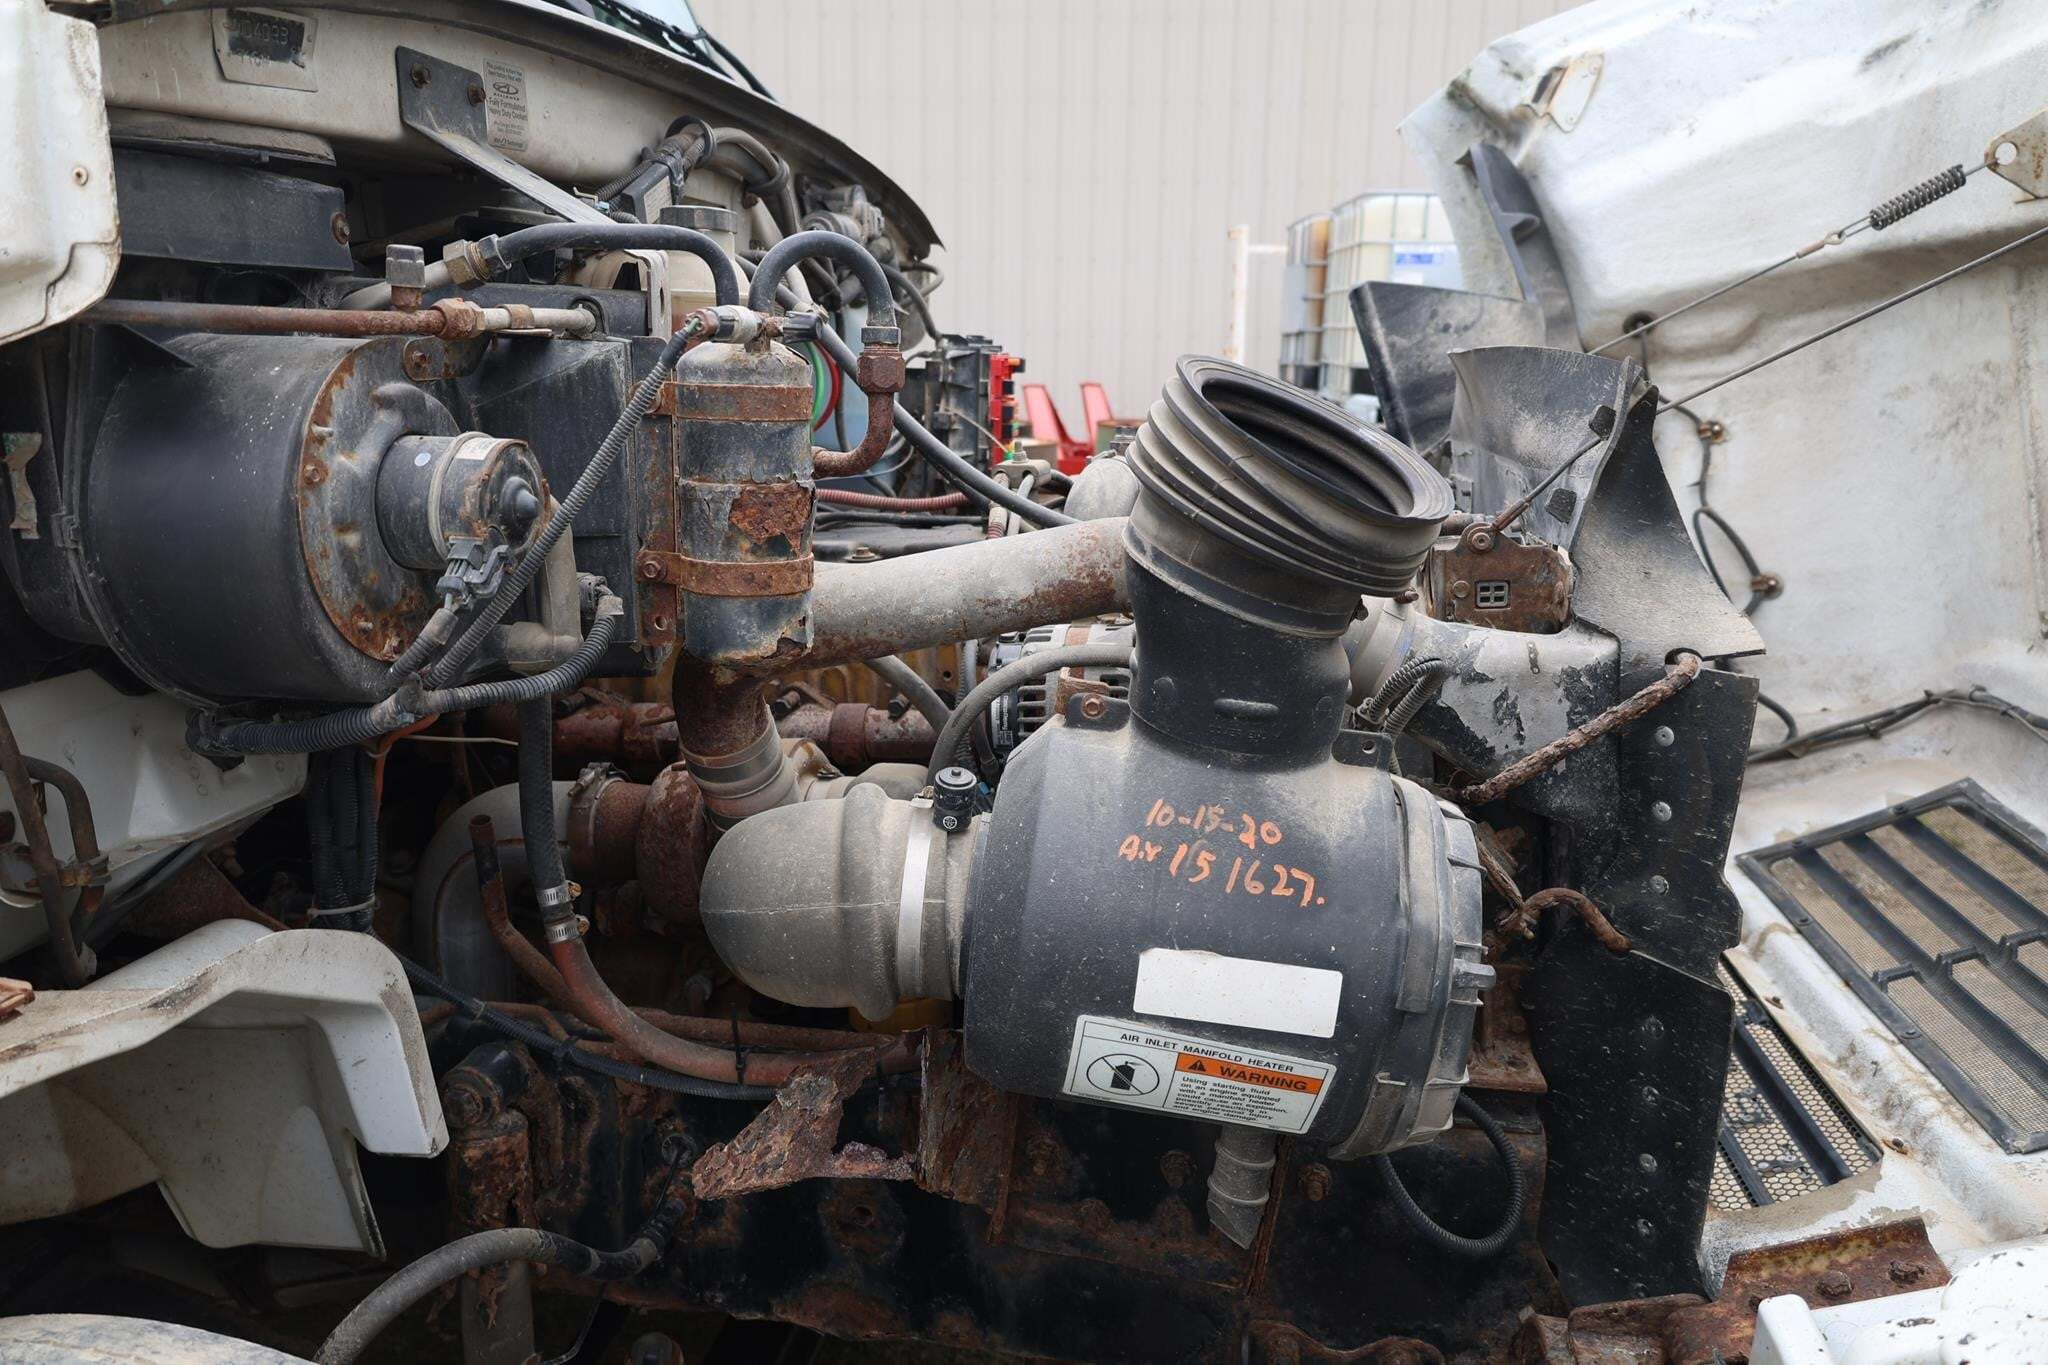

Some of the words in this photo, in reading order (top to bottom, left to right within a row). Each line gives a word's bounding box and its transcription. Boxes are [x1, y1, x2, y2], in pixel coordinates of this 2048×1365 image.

[1146, 799, 1282, 850] 10-15-20
[1121, 1033, 1139, 1043] AIR
[1145, 1037, 1178, 1049] INLET
[1183, 1045, 1242, 1063] MANIFOLD
[1248, 1058, 1294, 1072] HEATER
[1182, 1076, 1208, 1086] Using
[1213, 1082, 1246, 1092] starting
[1250, 1087, 1271, 1095] fluid
[1220, 1065, 1307, 1091] WARNING
[1209, 1088, 1238, 1096] engine
[1241, 1093, 1281, 1103] equipped
[1209, 1093, 1245, 1101] manifold
